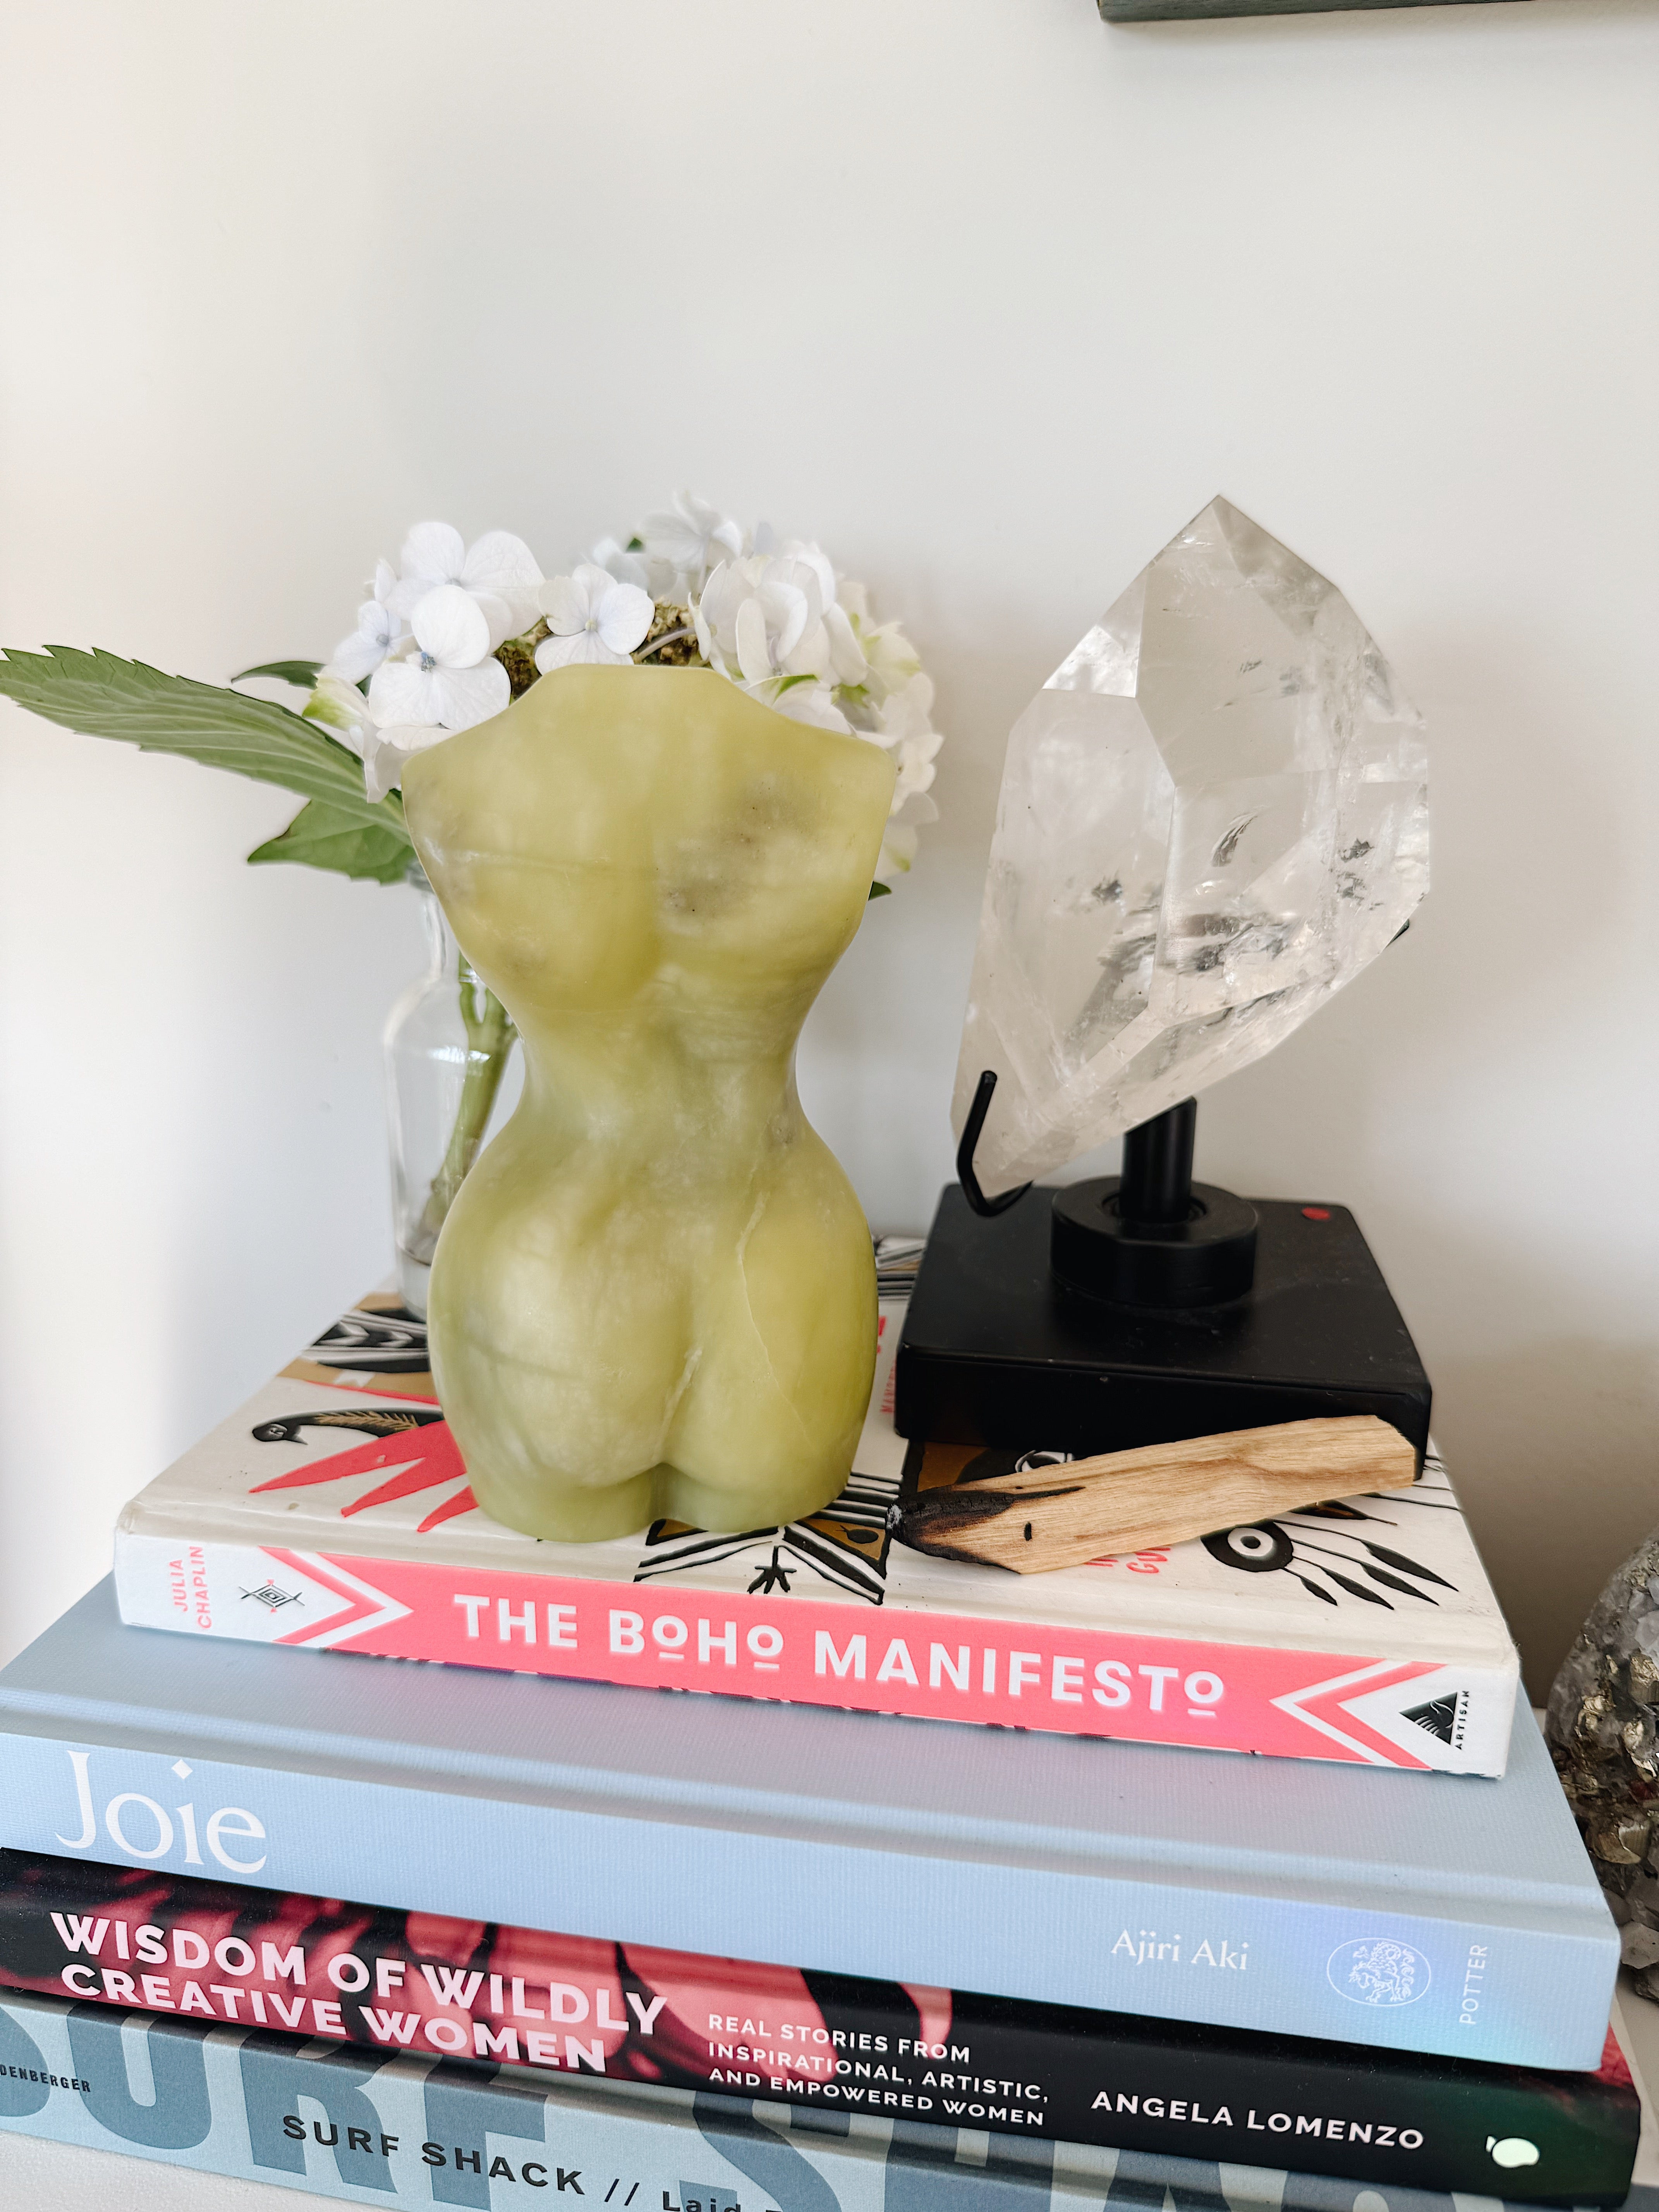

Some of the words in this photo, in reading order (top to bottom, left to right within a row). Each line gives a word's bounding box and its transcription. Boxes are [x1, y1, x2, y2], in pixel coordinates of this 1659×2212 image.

[170, 1559, 188, 1612] JULIA
[189, 1547, 211, 1628] CHAPLIN
[454, 1594, 577, 1648] THE
[1455, 1691, 1469, 1750] ARTISAN
[55, 1750, 267, 1873] Joie
[50, 1912, 306, 1985] WISDOM
[328, 1953, 405, 1997] OF
[421, 1964, 667, 2035] WILDLY
[1111, 1929, 1181, 1965] Ajiri
[1191, 1939, 1249, 1970] Aki
[1459, 1944, 1487, 2024] POTTER
[62, 1964, 346, 2035] CREATIVE
[359, 2006, 606, 2072] WOMEN
[709, 2014, 771, 2037] REAL
[781, 2024, 888, 2051] STORIES
[898, 2039, 970, 2063] FROM
[709, 2042, 912, 2085] INSPIRATIONAL,
[922, 2071, 1048, 2103] ARTISTIC,
[709, 2068, 760, 2087] AND
[770, 2076, 932, 2110] EMPOWERED
[943, 2099, 1044, 2126] WOMEN
[1091, 2091, 1234, 2126] ANGELA
[1247, 2110, 1424, 2149] LOMENZO
[283, 2115, 399, 2157] SURF
[422, 2142, 584, 2195] SHACK
